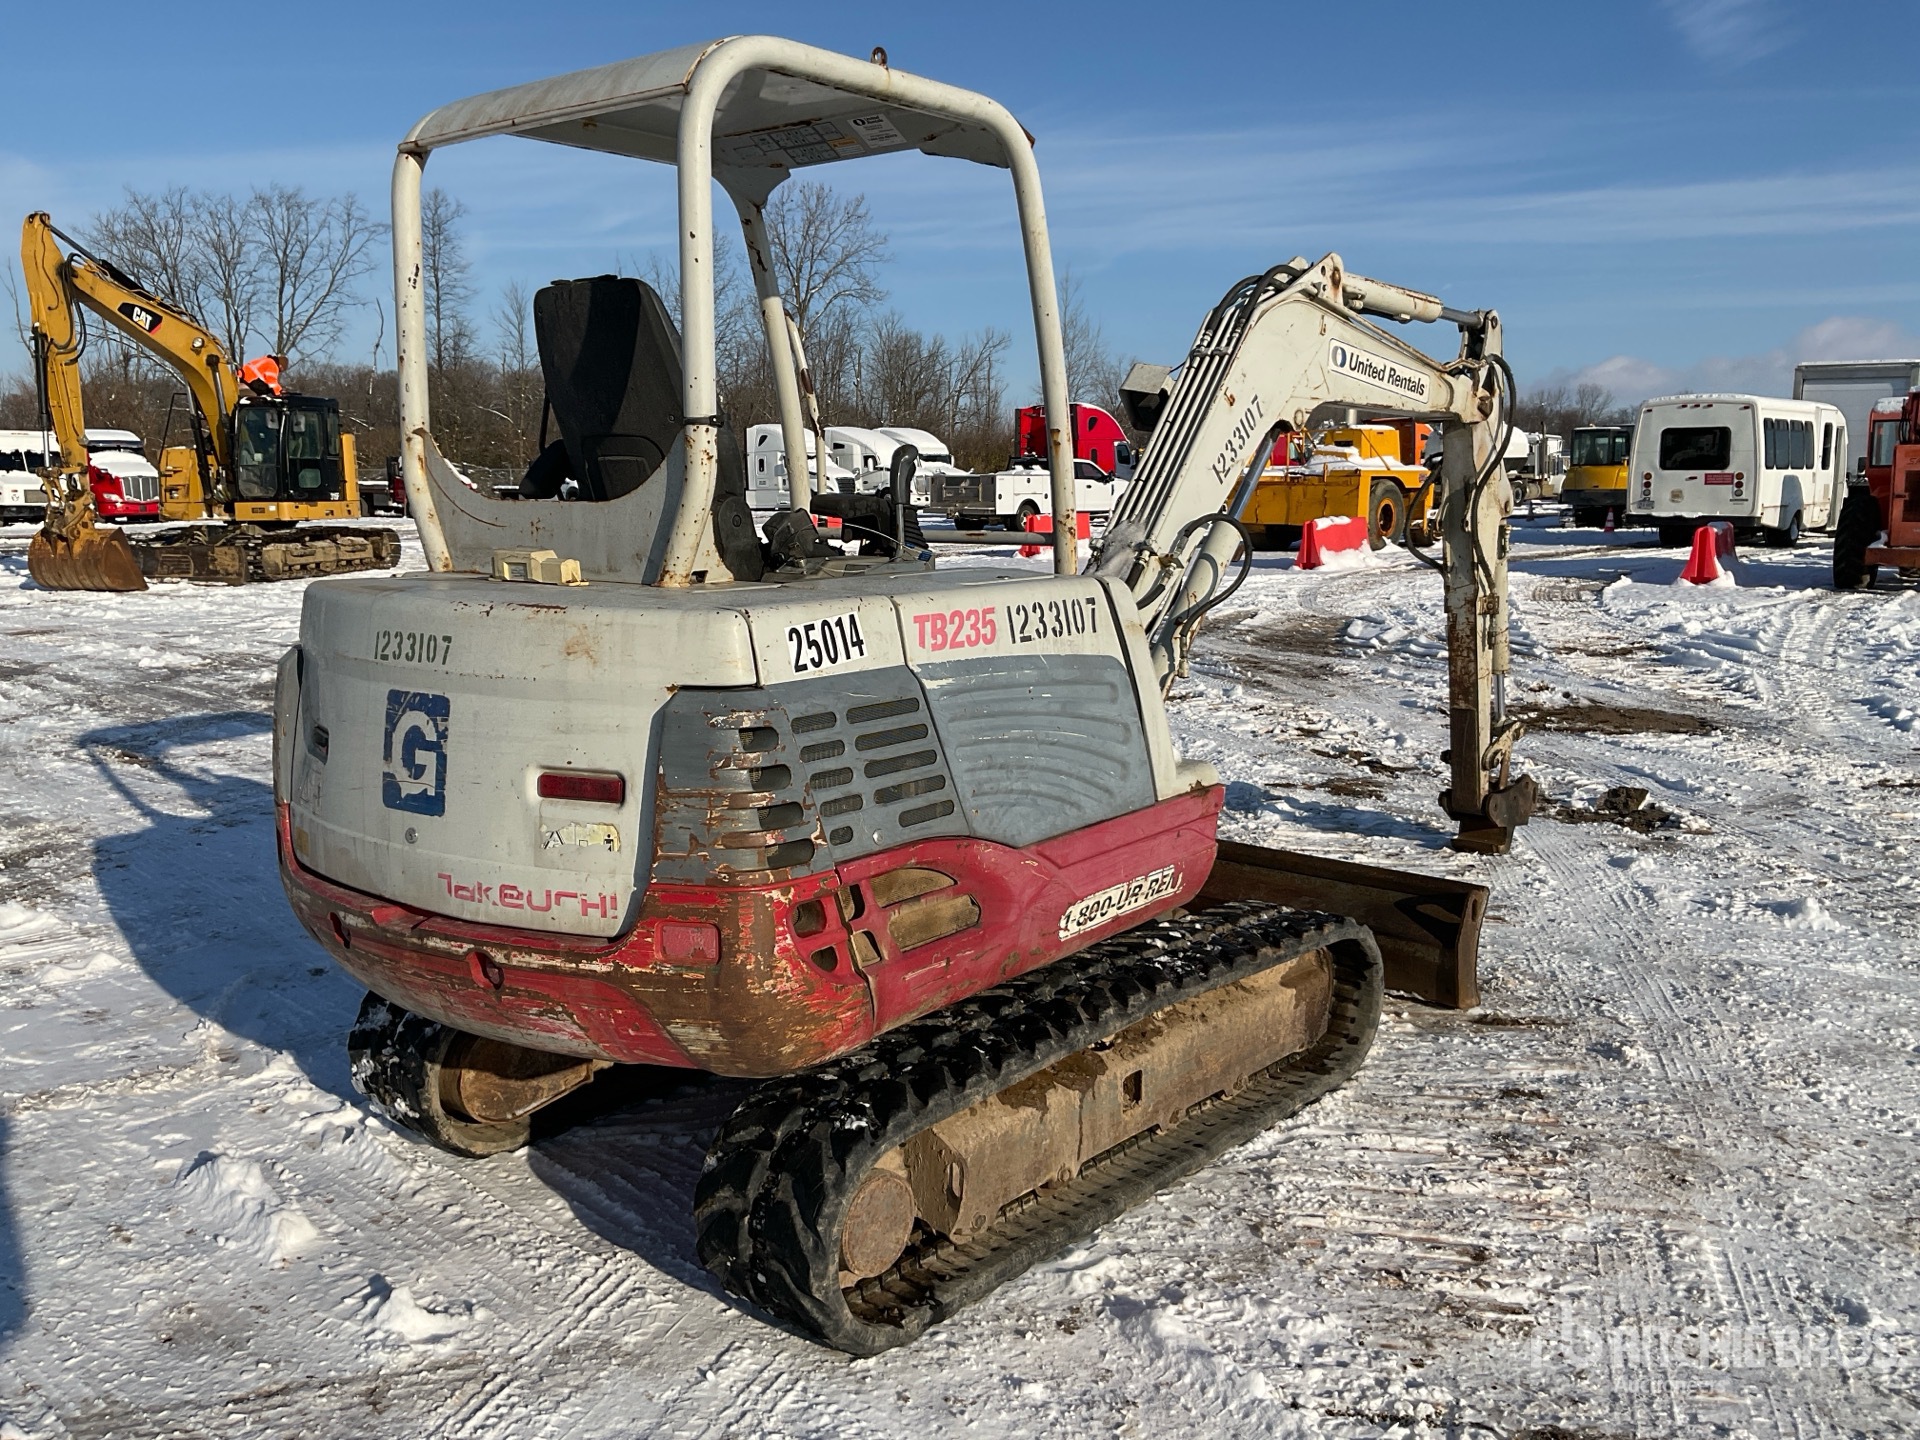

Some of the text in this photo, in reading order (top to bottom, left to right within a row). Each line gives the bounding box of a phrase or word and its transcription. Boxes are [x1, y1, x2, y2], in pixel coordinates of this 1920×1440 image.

[132, 306, 152, 330] CAT
[1349, 352, 1425, 396] United Rentals
[1211, 394, 1264, 485] 1233107
[374, 630, 453, 665] 1233107
[788, 614, 865, 673] 25014
[913, 596, 1097, 652] TB235 1233107
